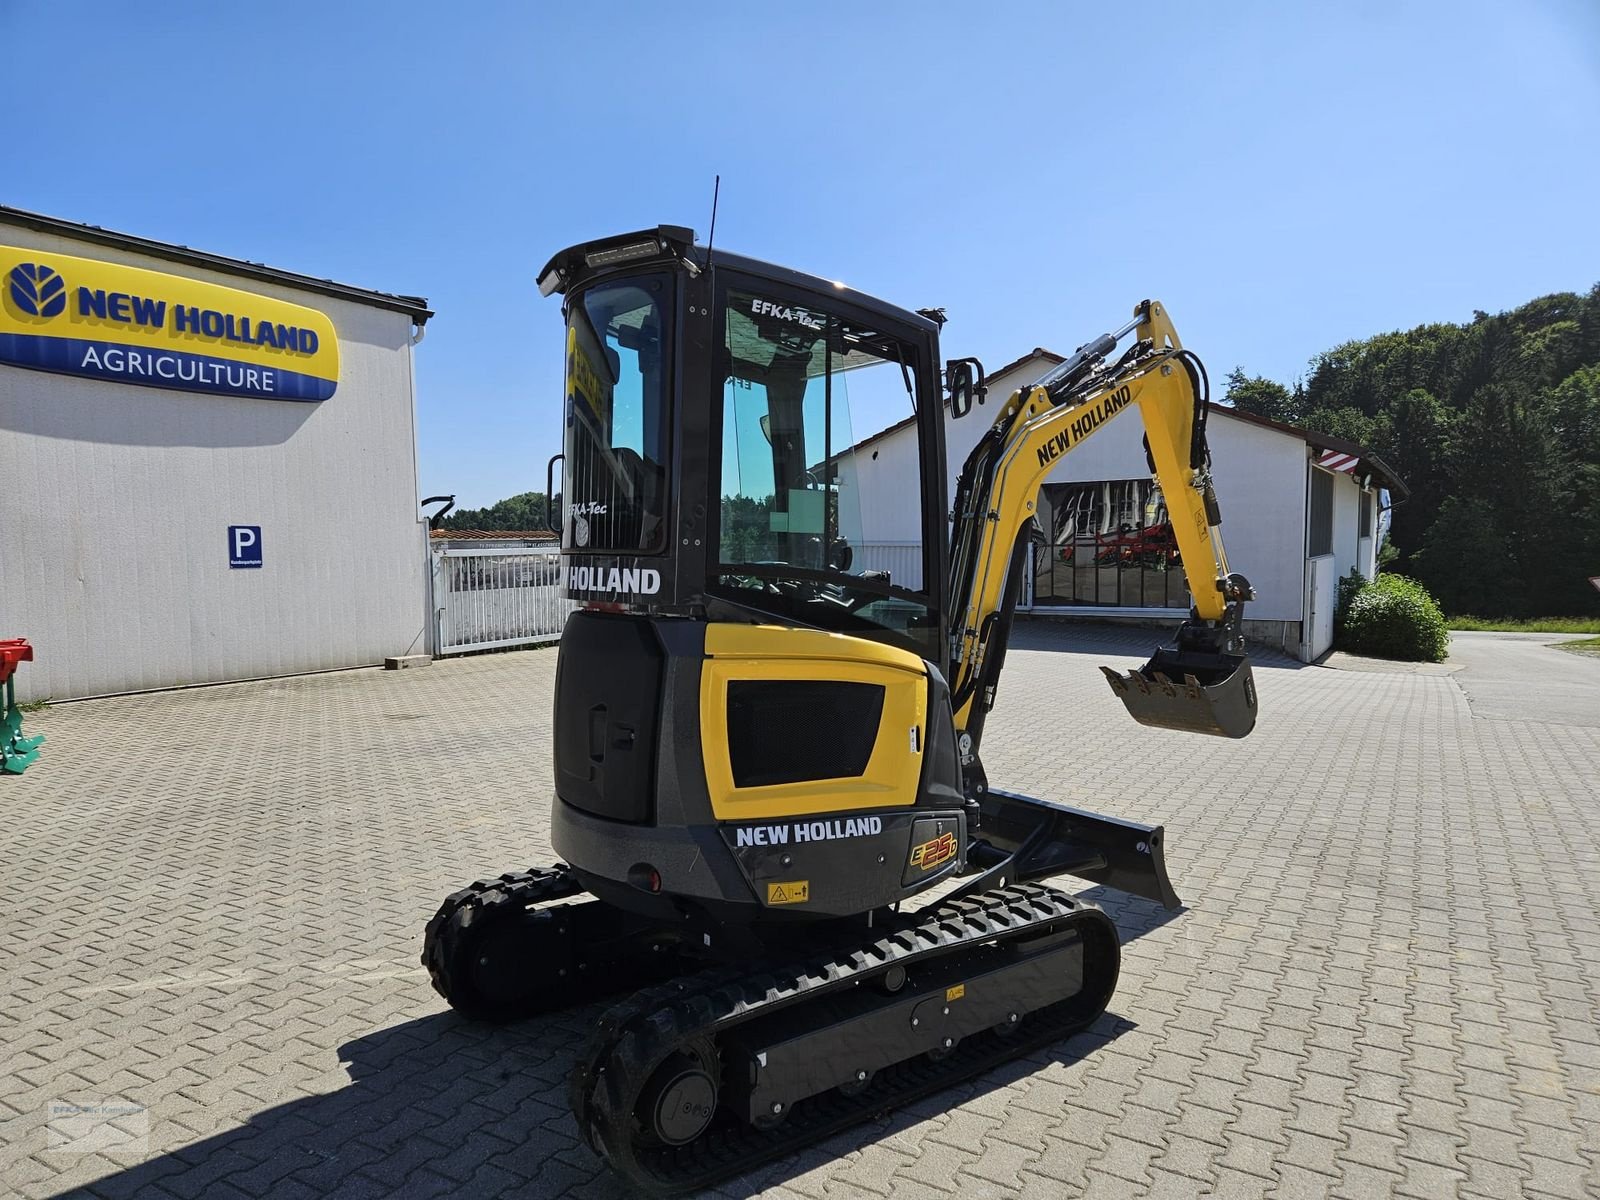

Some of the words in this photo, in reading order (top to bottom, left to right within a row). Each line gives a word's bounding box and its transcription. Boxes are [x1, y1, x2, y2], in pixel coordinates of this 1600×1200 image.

[78, 286, 166, 328] NEW
[175, 304, 319, 355] HOLLAND
[81, 346, 274, 392] AGRICULTURE
[1036, 428, 1070, 468] NEW
[1071, 385, 1131, 442] HOLLAND
[235, 528, 256, 558] P
[569, 566, 661, 595] HOLLAND
[736, 825, 789, 847] NEW
[794, 816, 882, 843] HOLLAND
